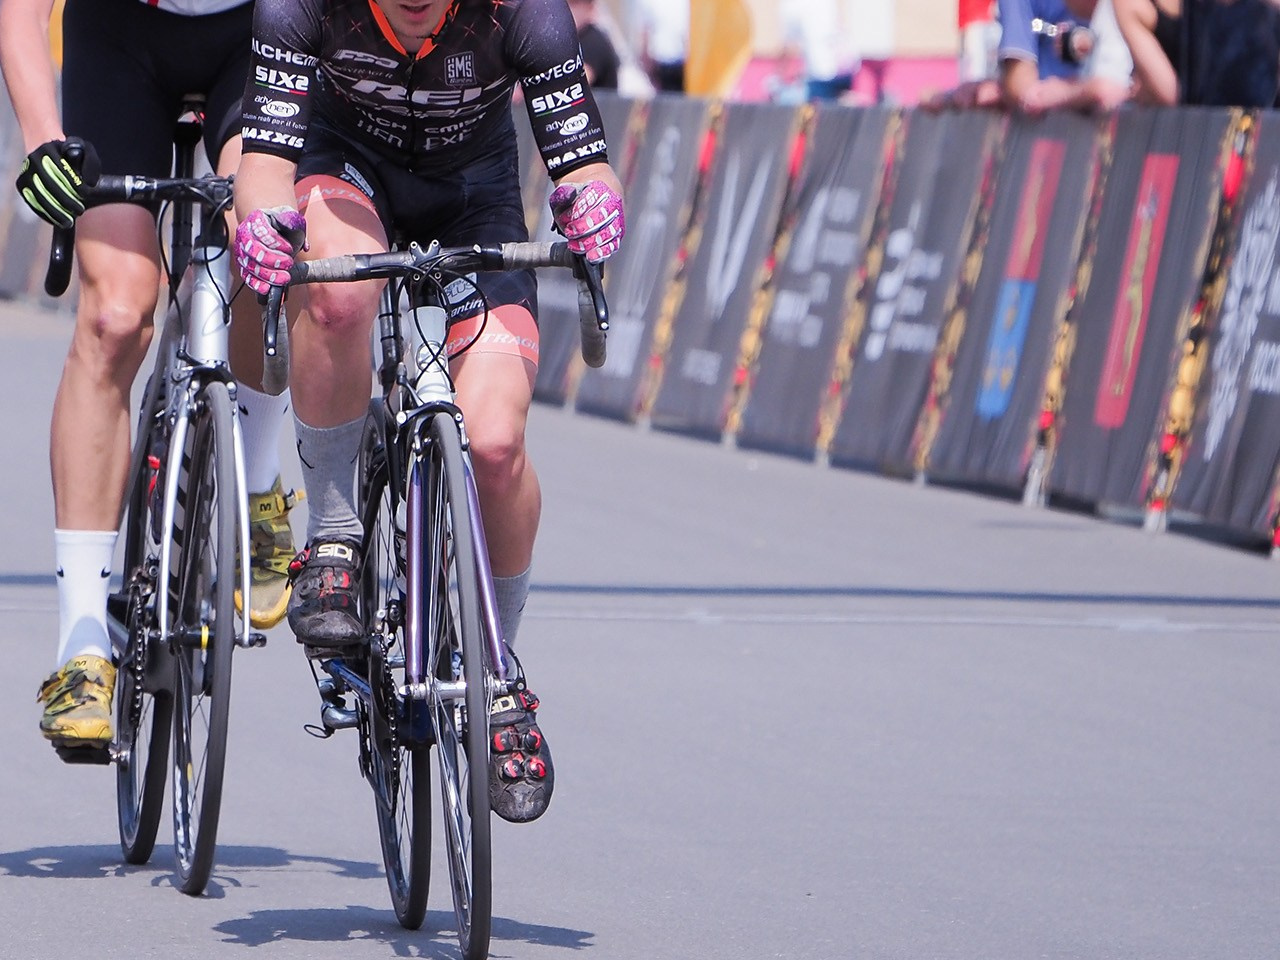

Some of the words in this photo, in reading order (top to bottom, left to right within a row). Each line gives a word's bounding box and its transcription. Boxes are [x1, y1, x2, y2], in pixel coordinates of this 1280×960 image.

[255, 65, 309, 91] SIX2
[447, 54, 473, 79] SMS
[531, 82, 584, 113] SIX2
[451, 298, 485, 319] antin
[317, 543, 354, 562] SIDI
